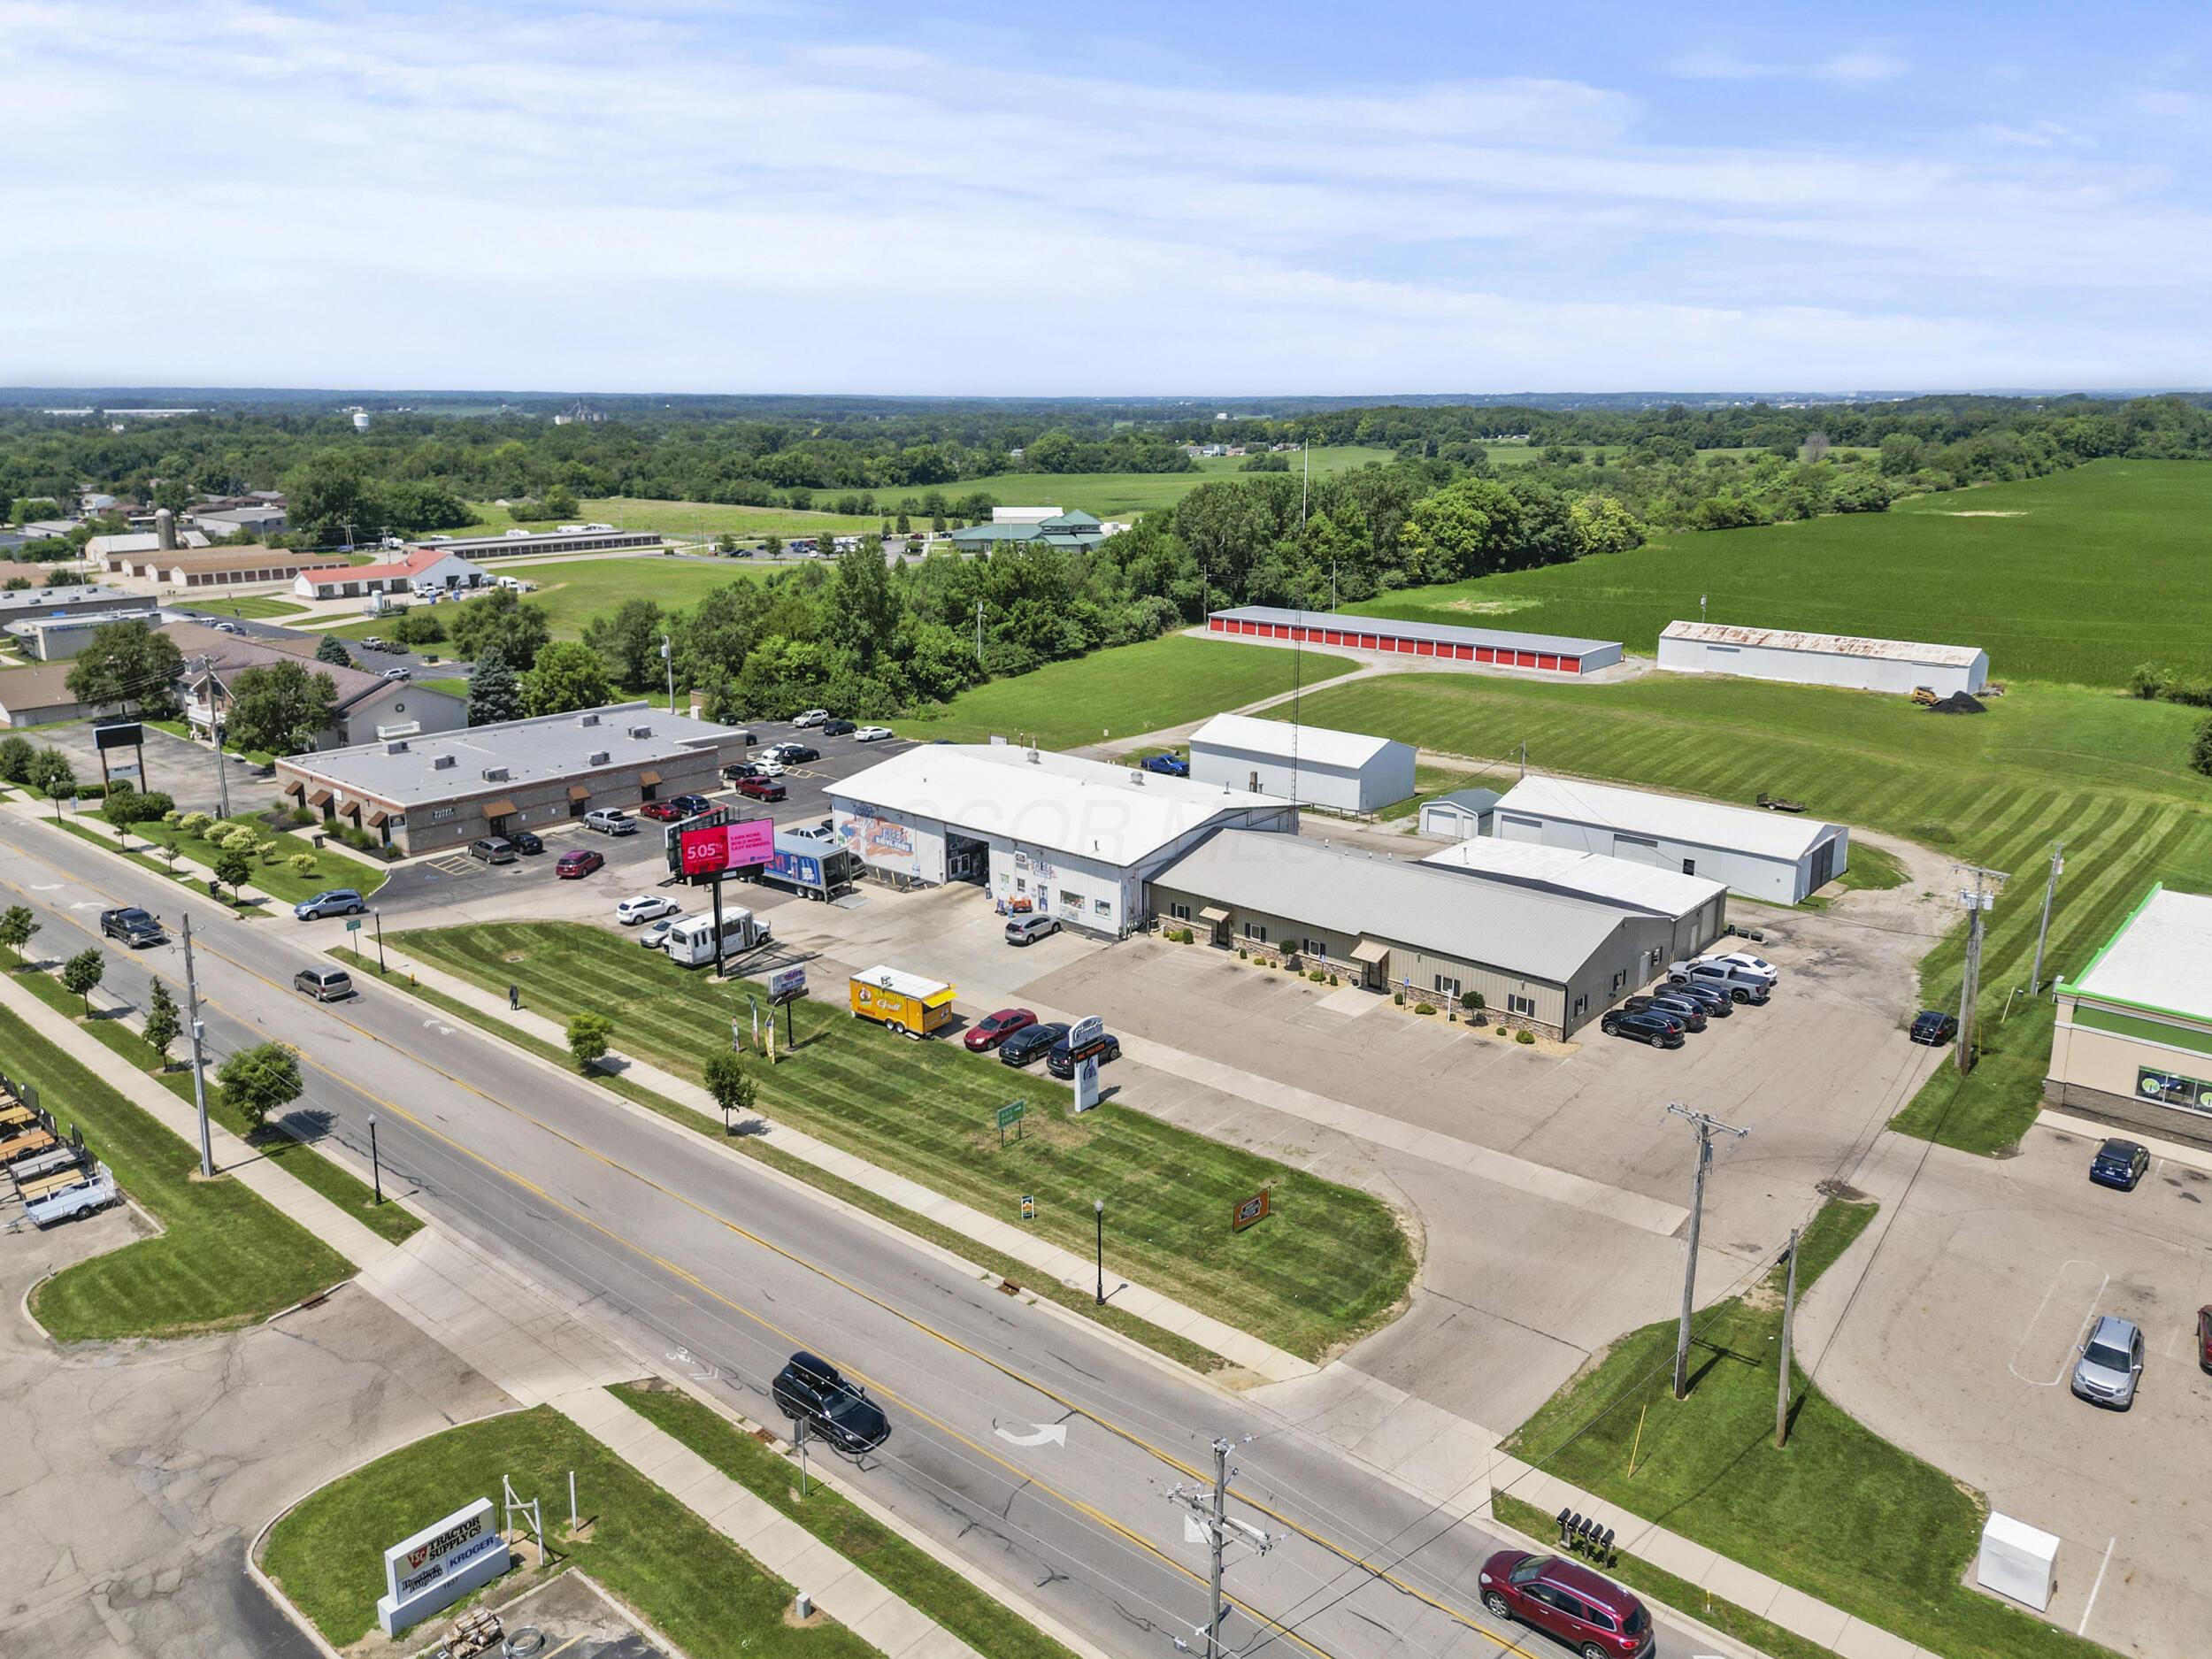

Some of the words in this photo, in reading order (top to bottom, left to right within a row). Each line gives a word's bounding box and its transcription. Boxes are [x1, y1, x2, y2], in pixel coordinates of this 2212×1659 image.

[428, 1516, 480, 1550] TRACTOR
[429, 1532, 469, 1561] SUPPLY
[410, 1549, 426, 1563] TSC
[449, 1537, 495, 1568] KROGER
